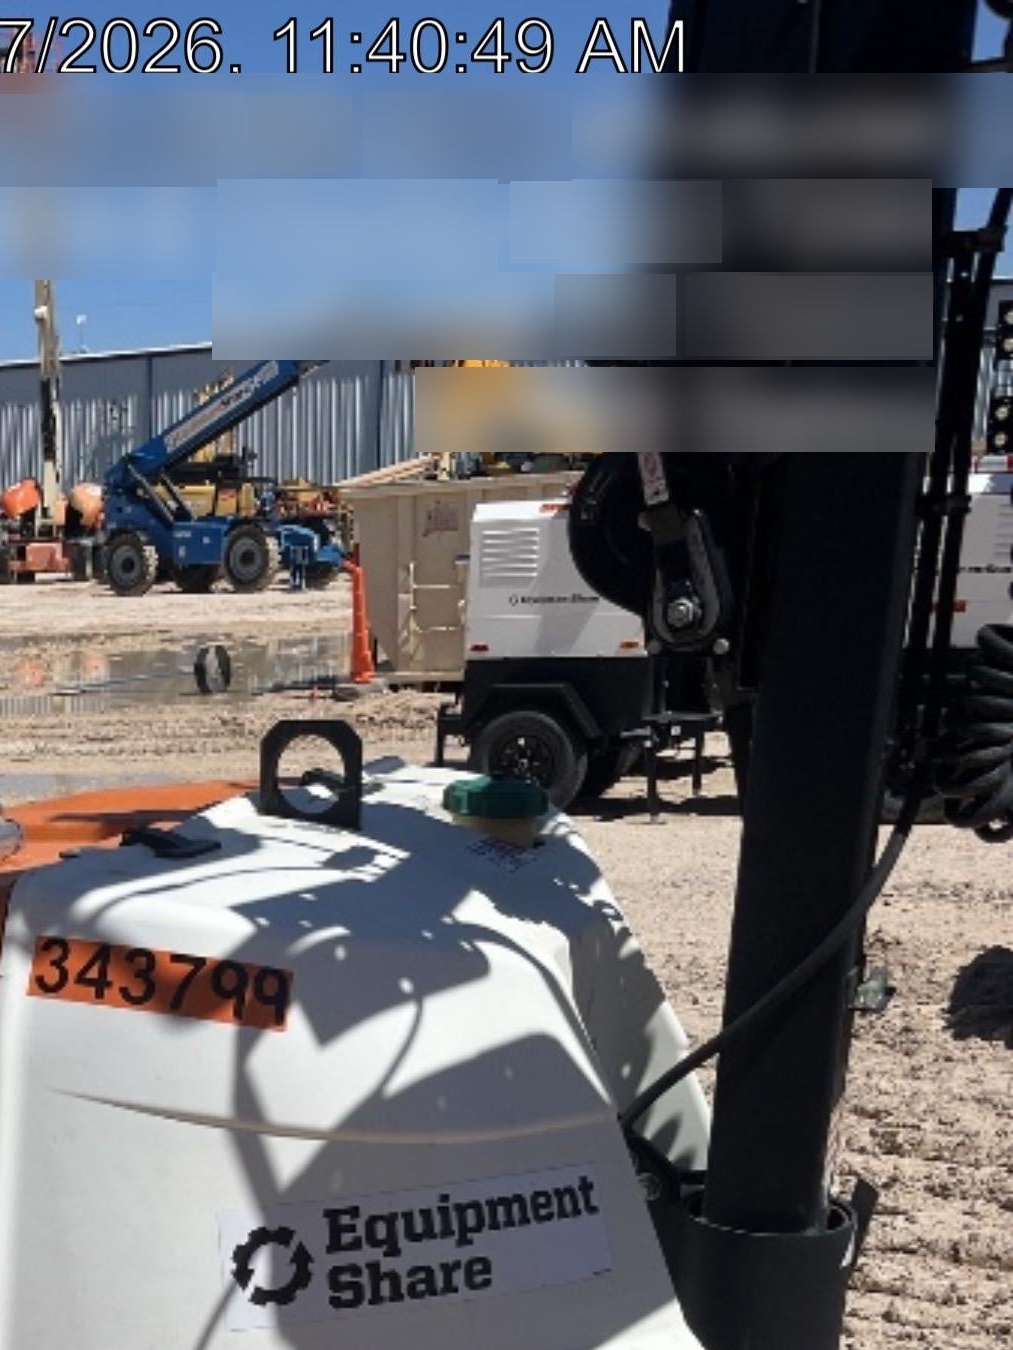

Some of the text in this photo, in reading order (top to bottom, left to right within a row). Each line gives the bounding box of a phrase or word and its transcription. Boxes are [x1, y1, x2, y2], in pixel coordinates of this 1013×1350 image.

[34, 936, 292, 1027] 343799
[324, 1174, 599, 1257] Equipment
[328, 1255, 492, 1310] Share
